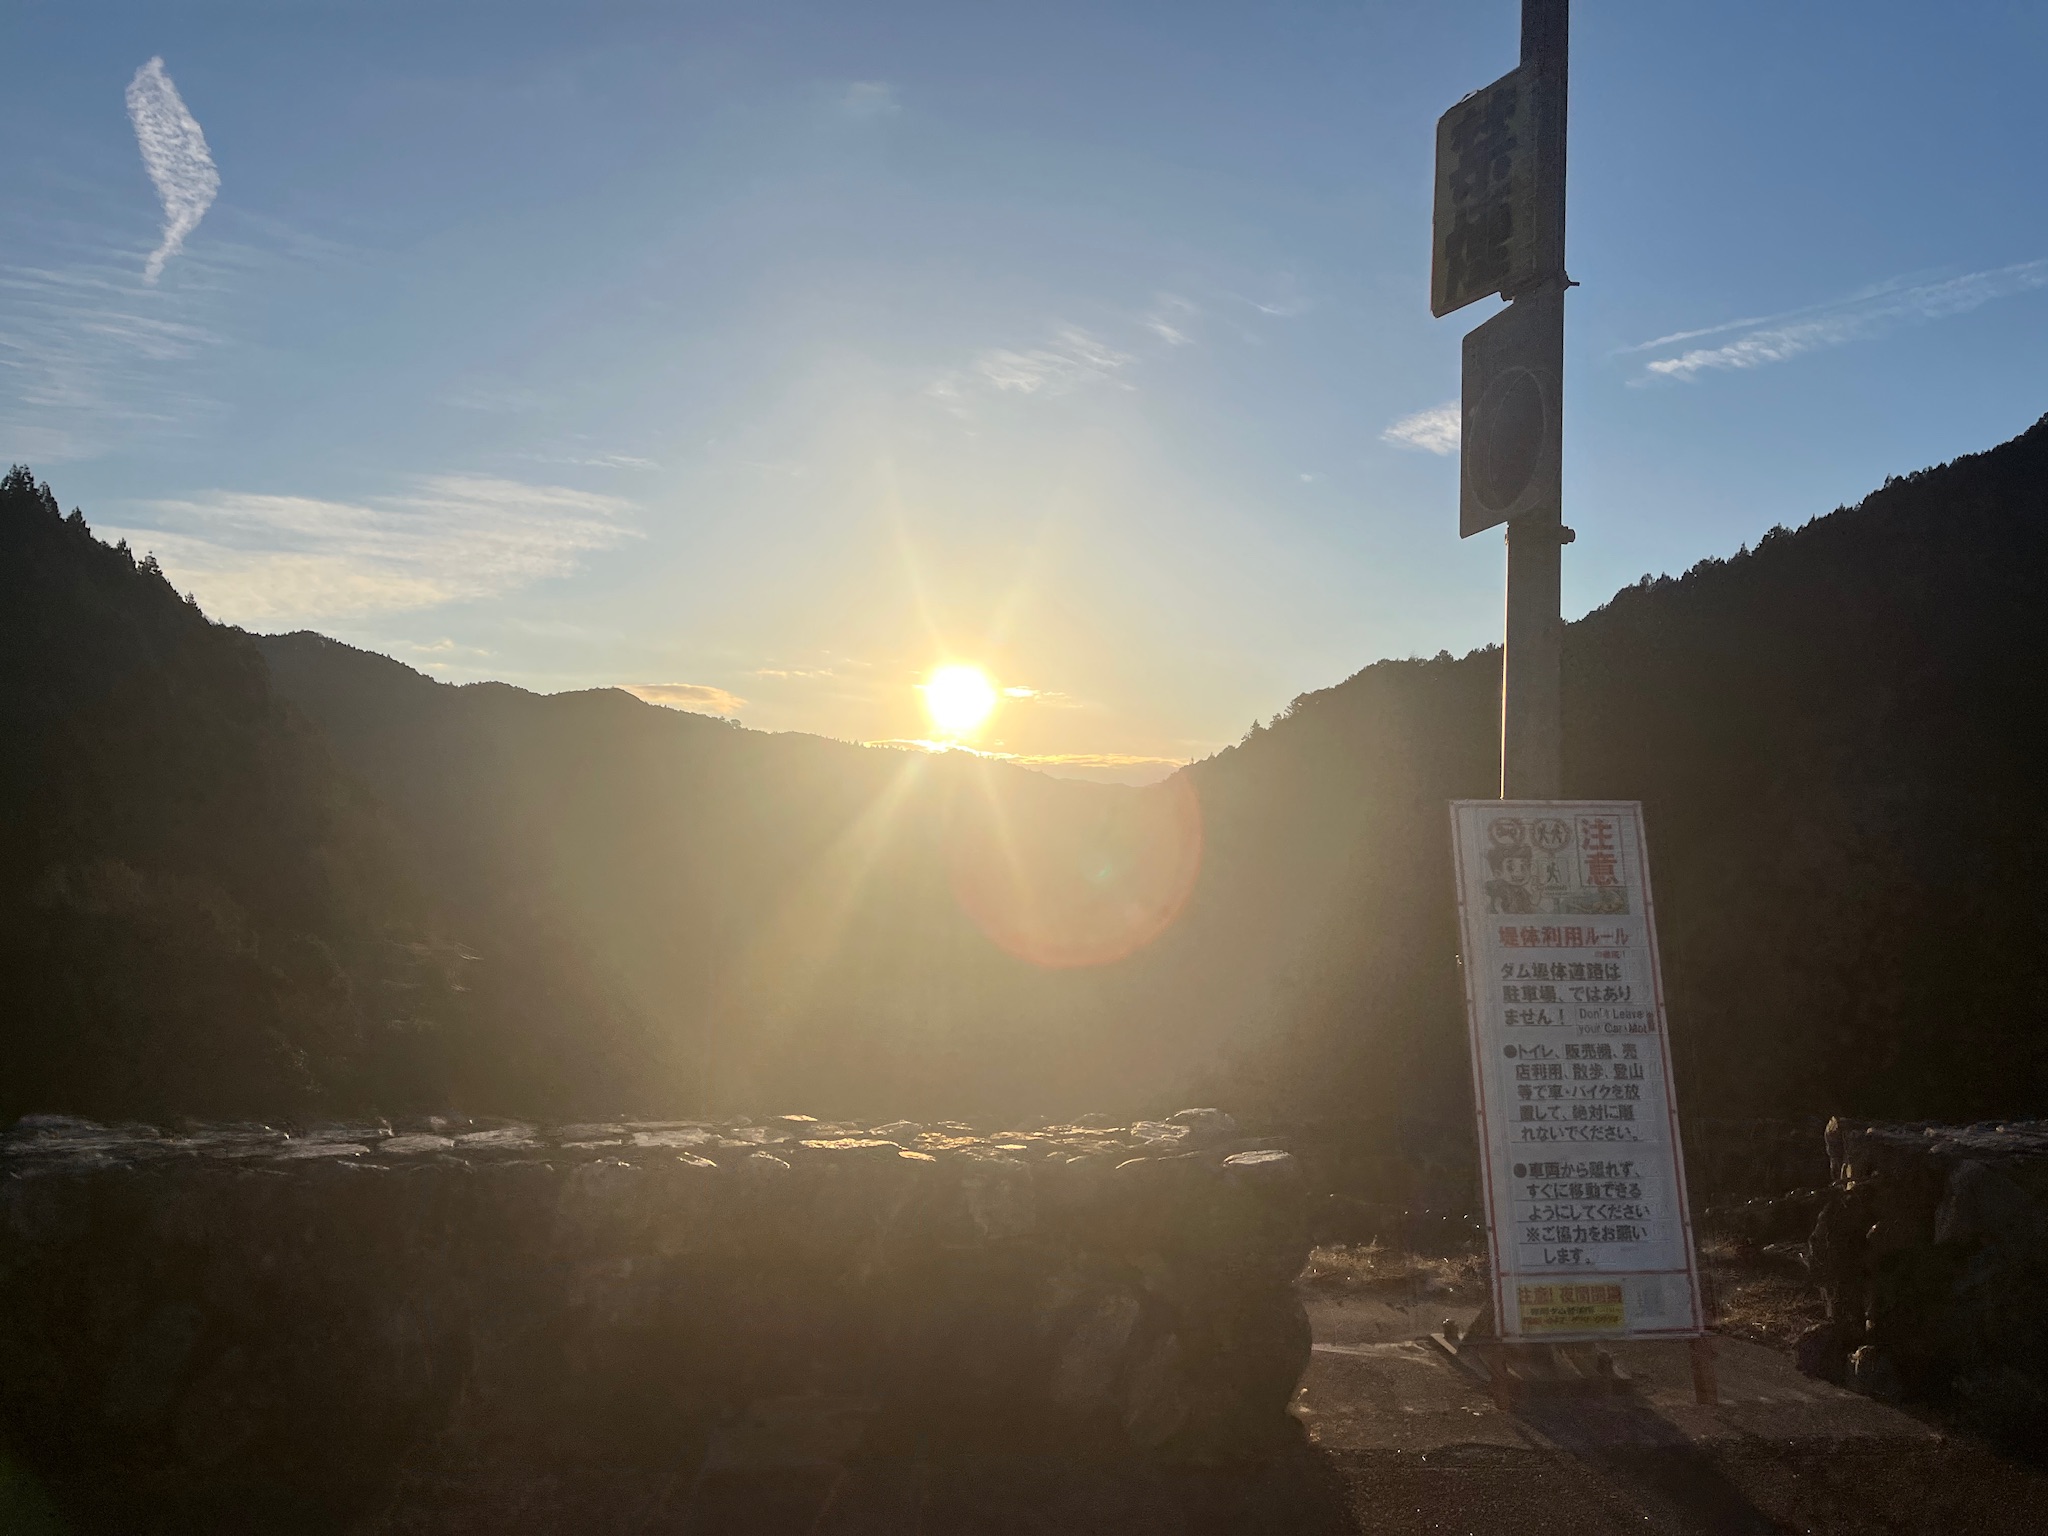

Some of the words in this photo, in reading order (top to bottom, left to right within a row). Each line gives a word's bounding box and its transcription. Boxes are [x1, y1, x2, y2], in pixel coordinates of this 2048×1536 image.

[1582, 819, 1618, 885] 注意
[1498, 926, 1630, 947] 堤体利用ルール
[1500, 962, 1622, 980] ダム堤体道路は
[1613, 1008, 1644, 1020] Leave
[1577, 1025, 1601, 1036] your
[1521, 1125, 1639, 1142] れないでください。
[1526, 1182, 1642, 1199] すぐに移動できる
[1528, 1204, 1651, 1221] ようにしてください
[1543, 1247, 1592, 1264] します。
